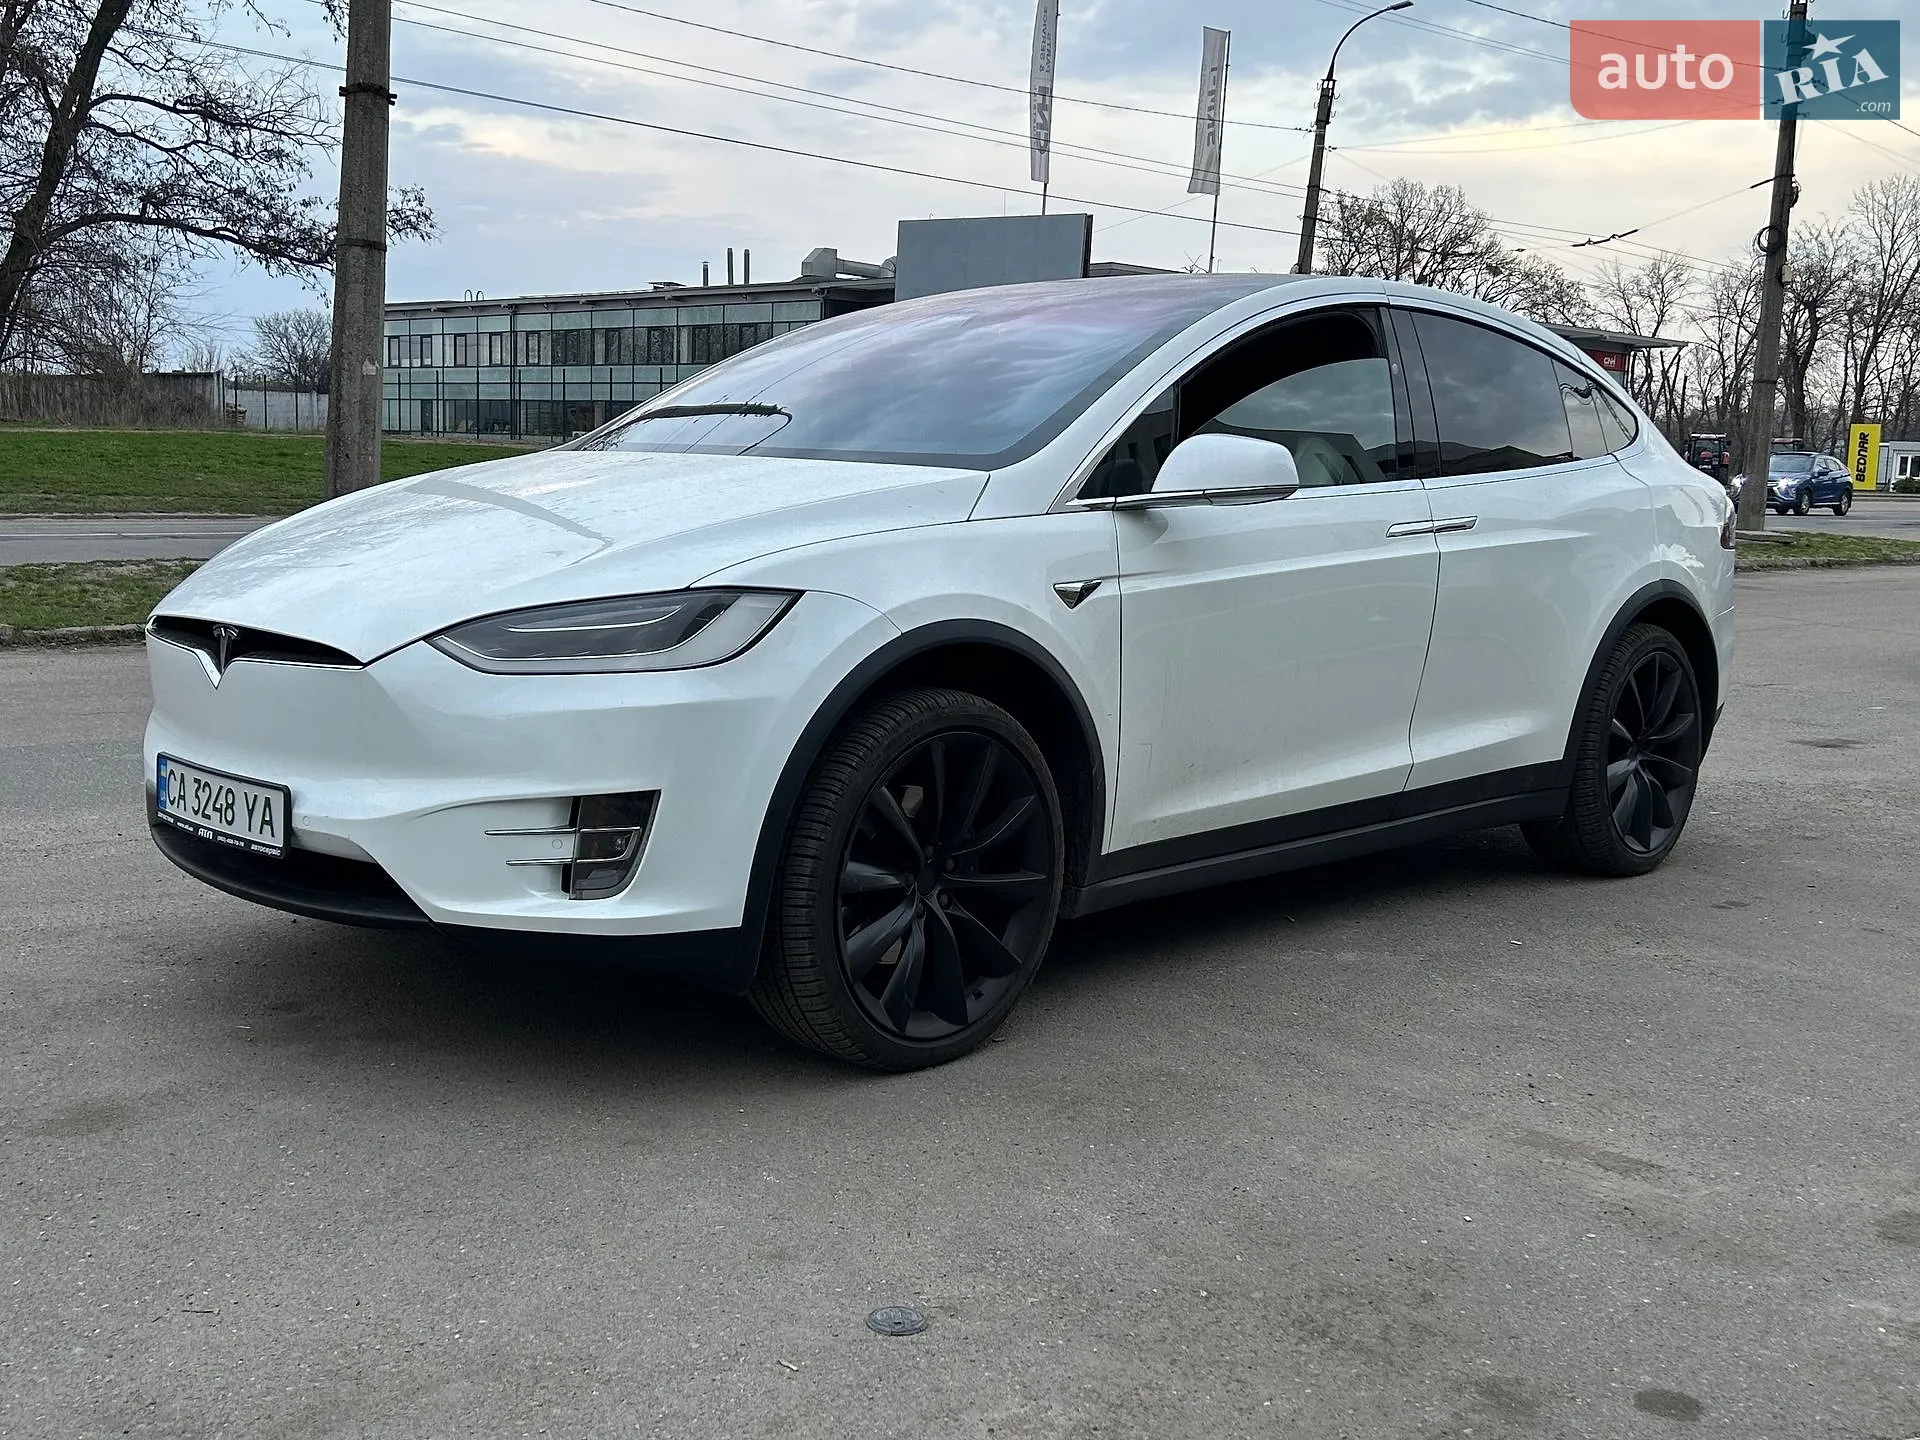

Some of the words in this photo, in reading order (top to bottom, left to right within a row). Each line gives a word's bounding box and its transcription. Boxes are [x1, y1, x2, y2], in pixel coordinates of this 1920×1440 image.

[1855, 431, 1870, 483] BEDNAR
[167, 768, 187, 812] CA
[191, 777, 236, 826] 3248
[243, 791, 275, 838] YA
